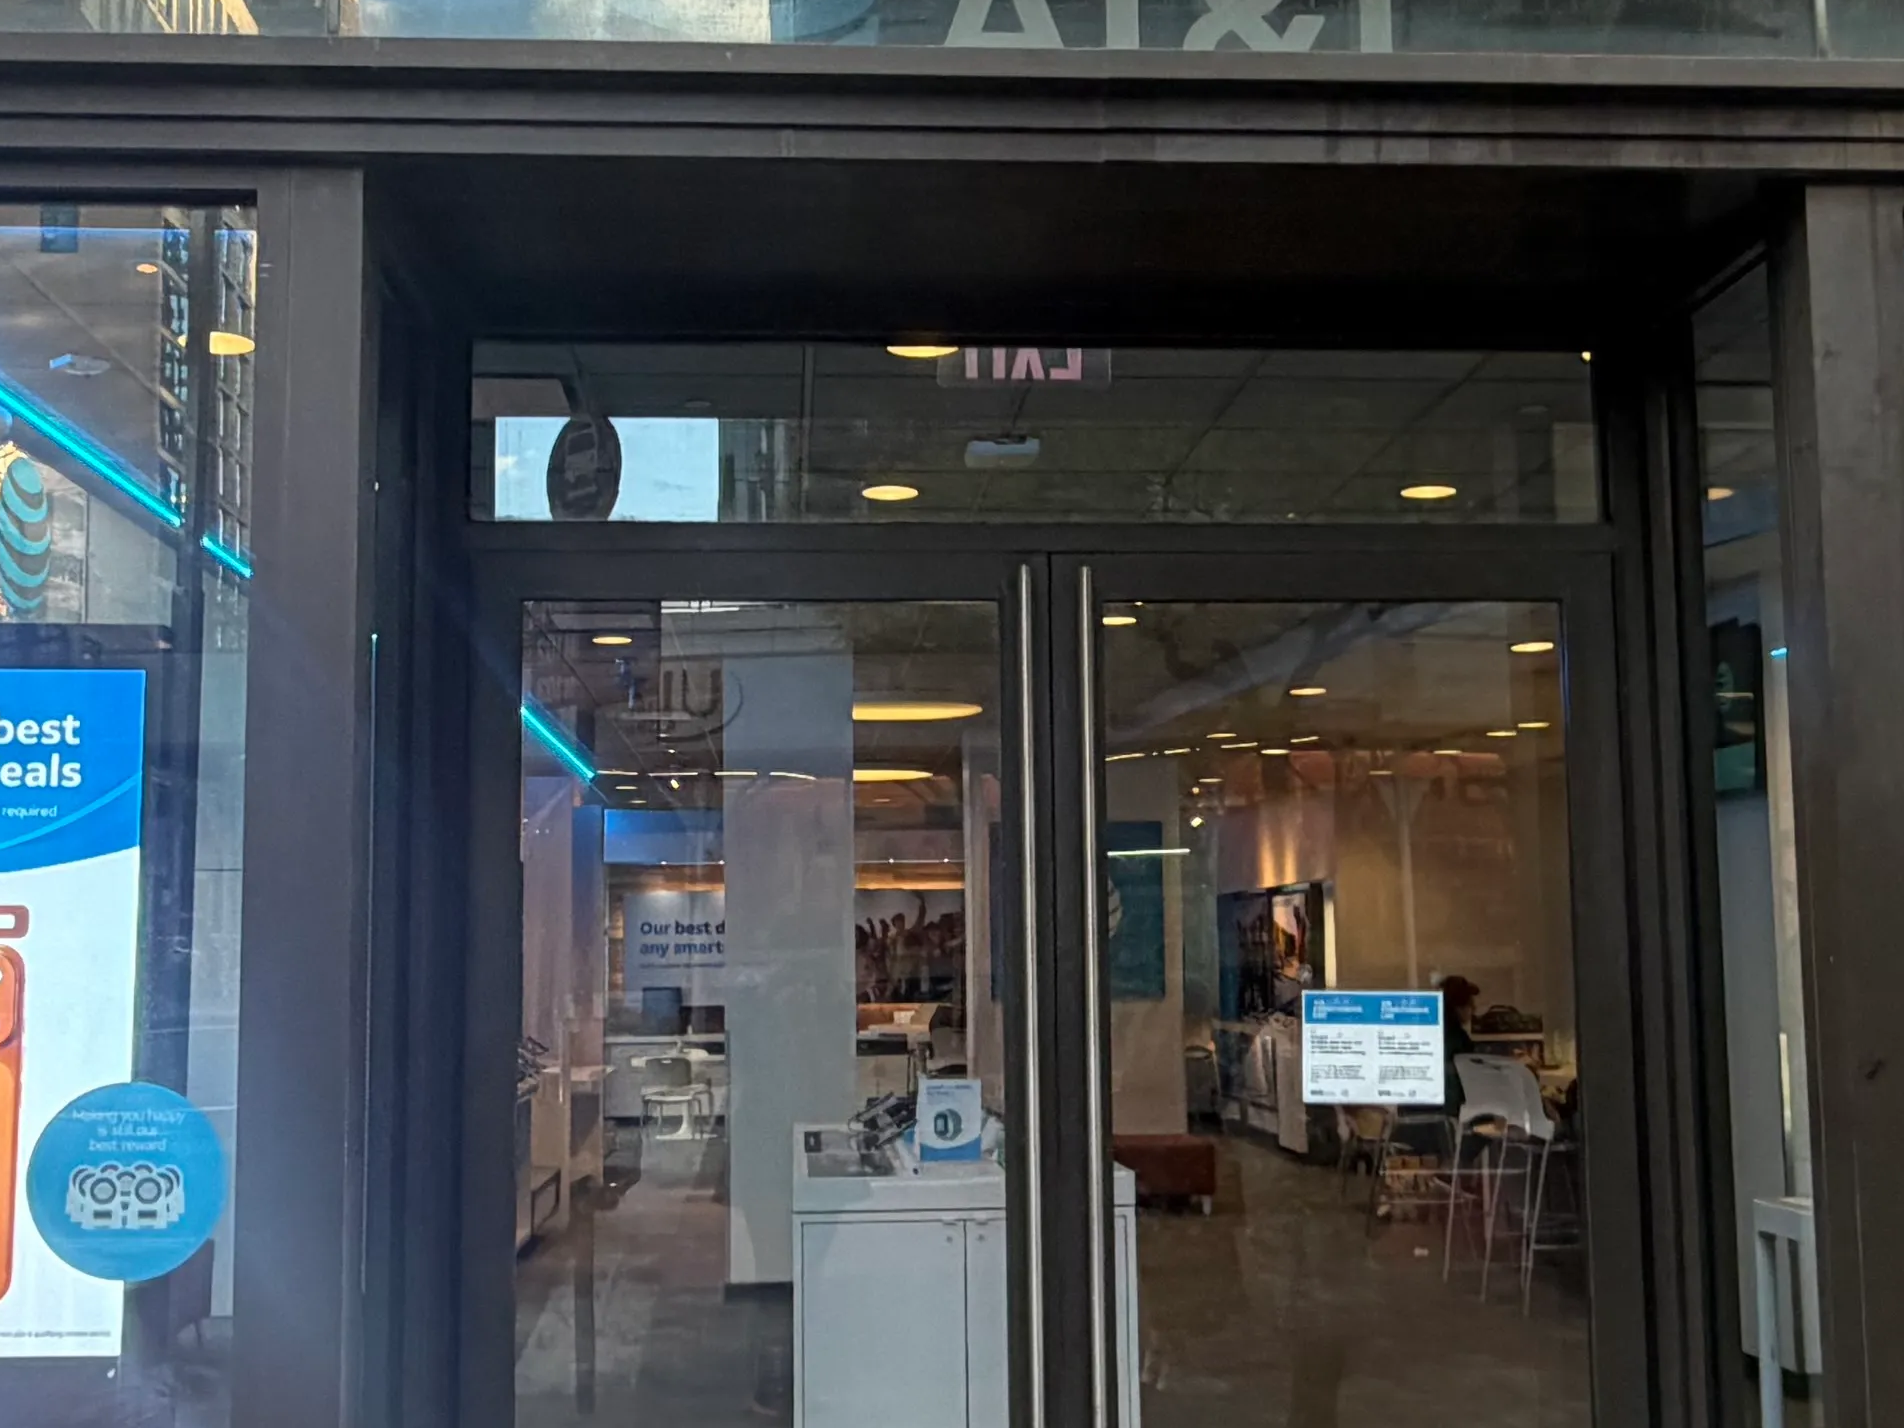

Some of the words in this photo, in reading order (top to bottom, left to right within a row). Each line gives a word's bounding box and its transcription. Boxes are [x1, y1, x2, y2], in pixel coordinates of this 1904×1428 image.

[2, 805, 58, 819] required
[639, 921, 672, 936] Our
[674, 919, 713, 936] best
[639, 942, 669, 959] any
